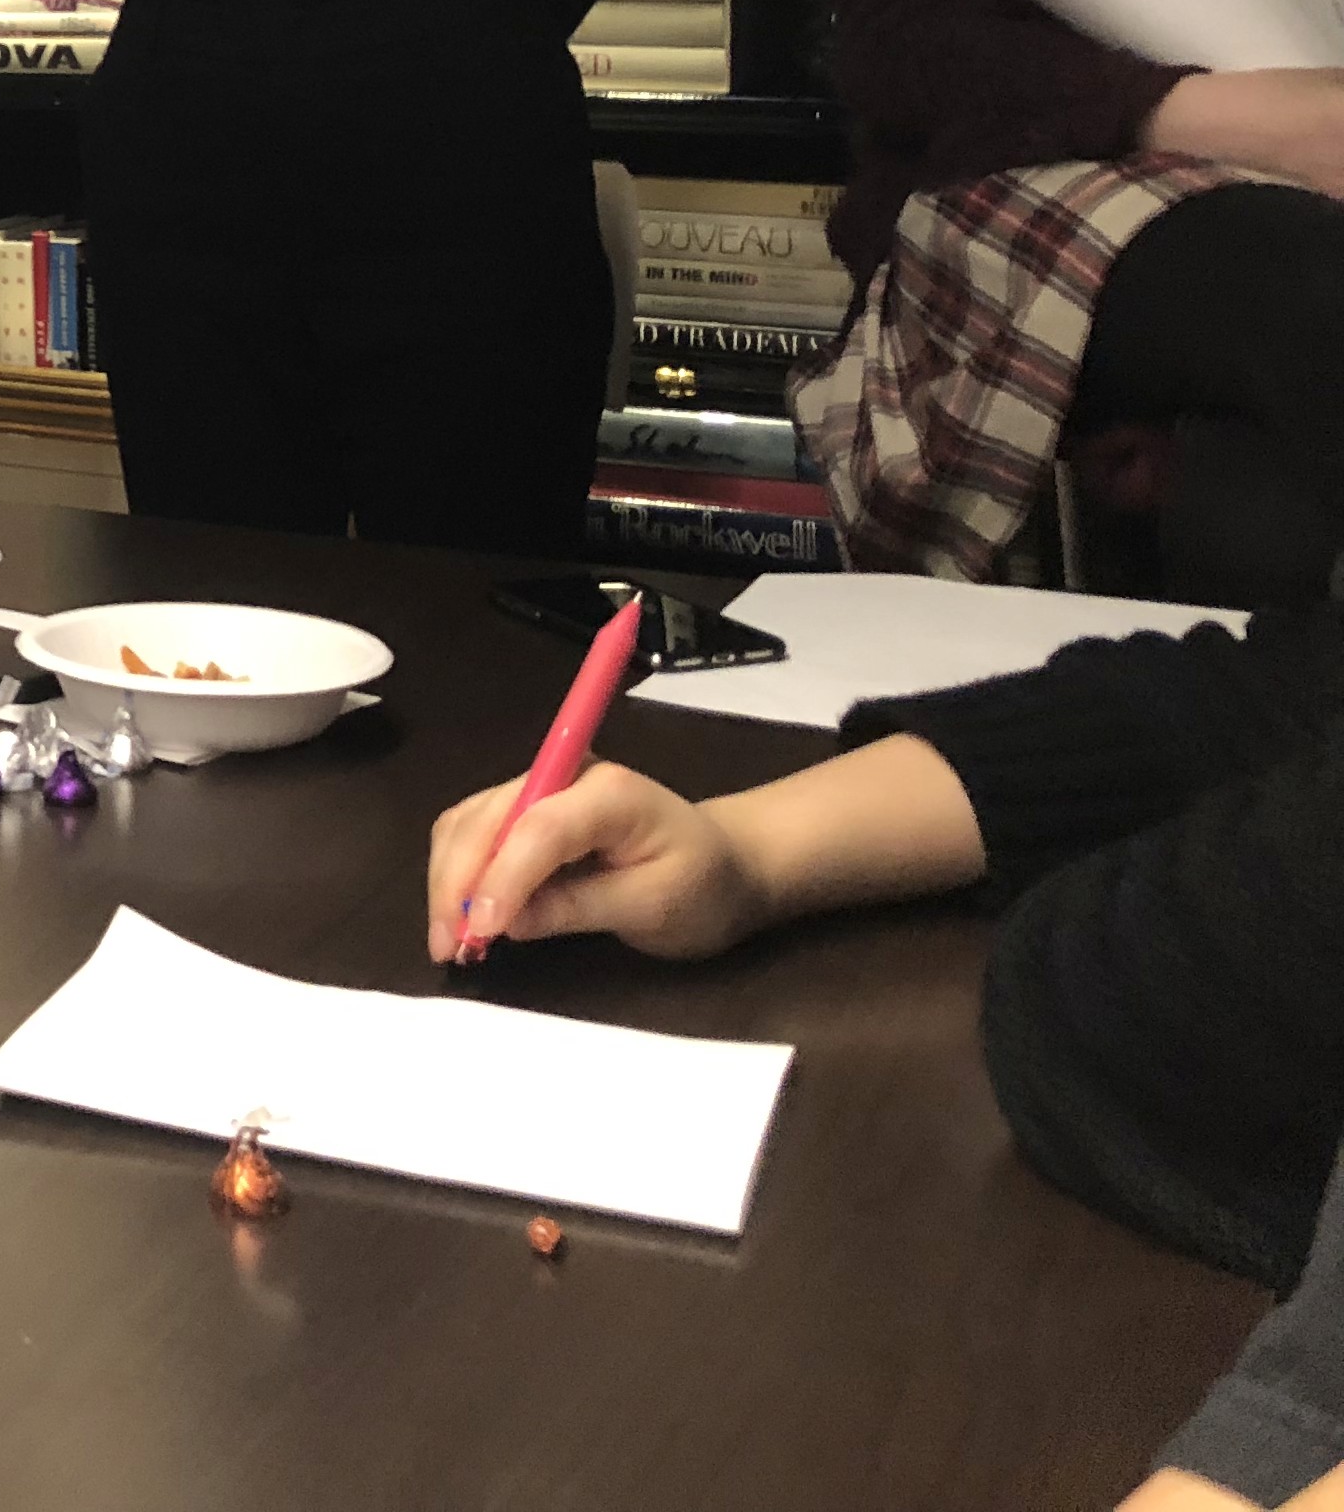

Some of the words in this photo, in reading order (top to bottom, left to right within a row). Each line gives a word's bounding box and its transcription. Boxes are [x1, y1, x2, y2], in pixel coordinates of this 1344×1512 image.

[645, 265, 665, 280] IN
[670, 267, 705, 284] THE
[708, 270, 760, 287] MIND
